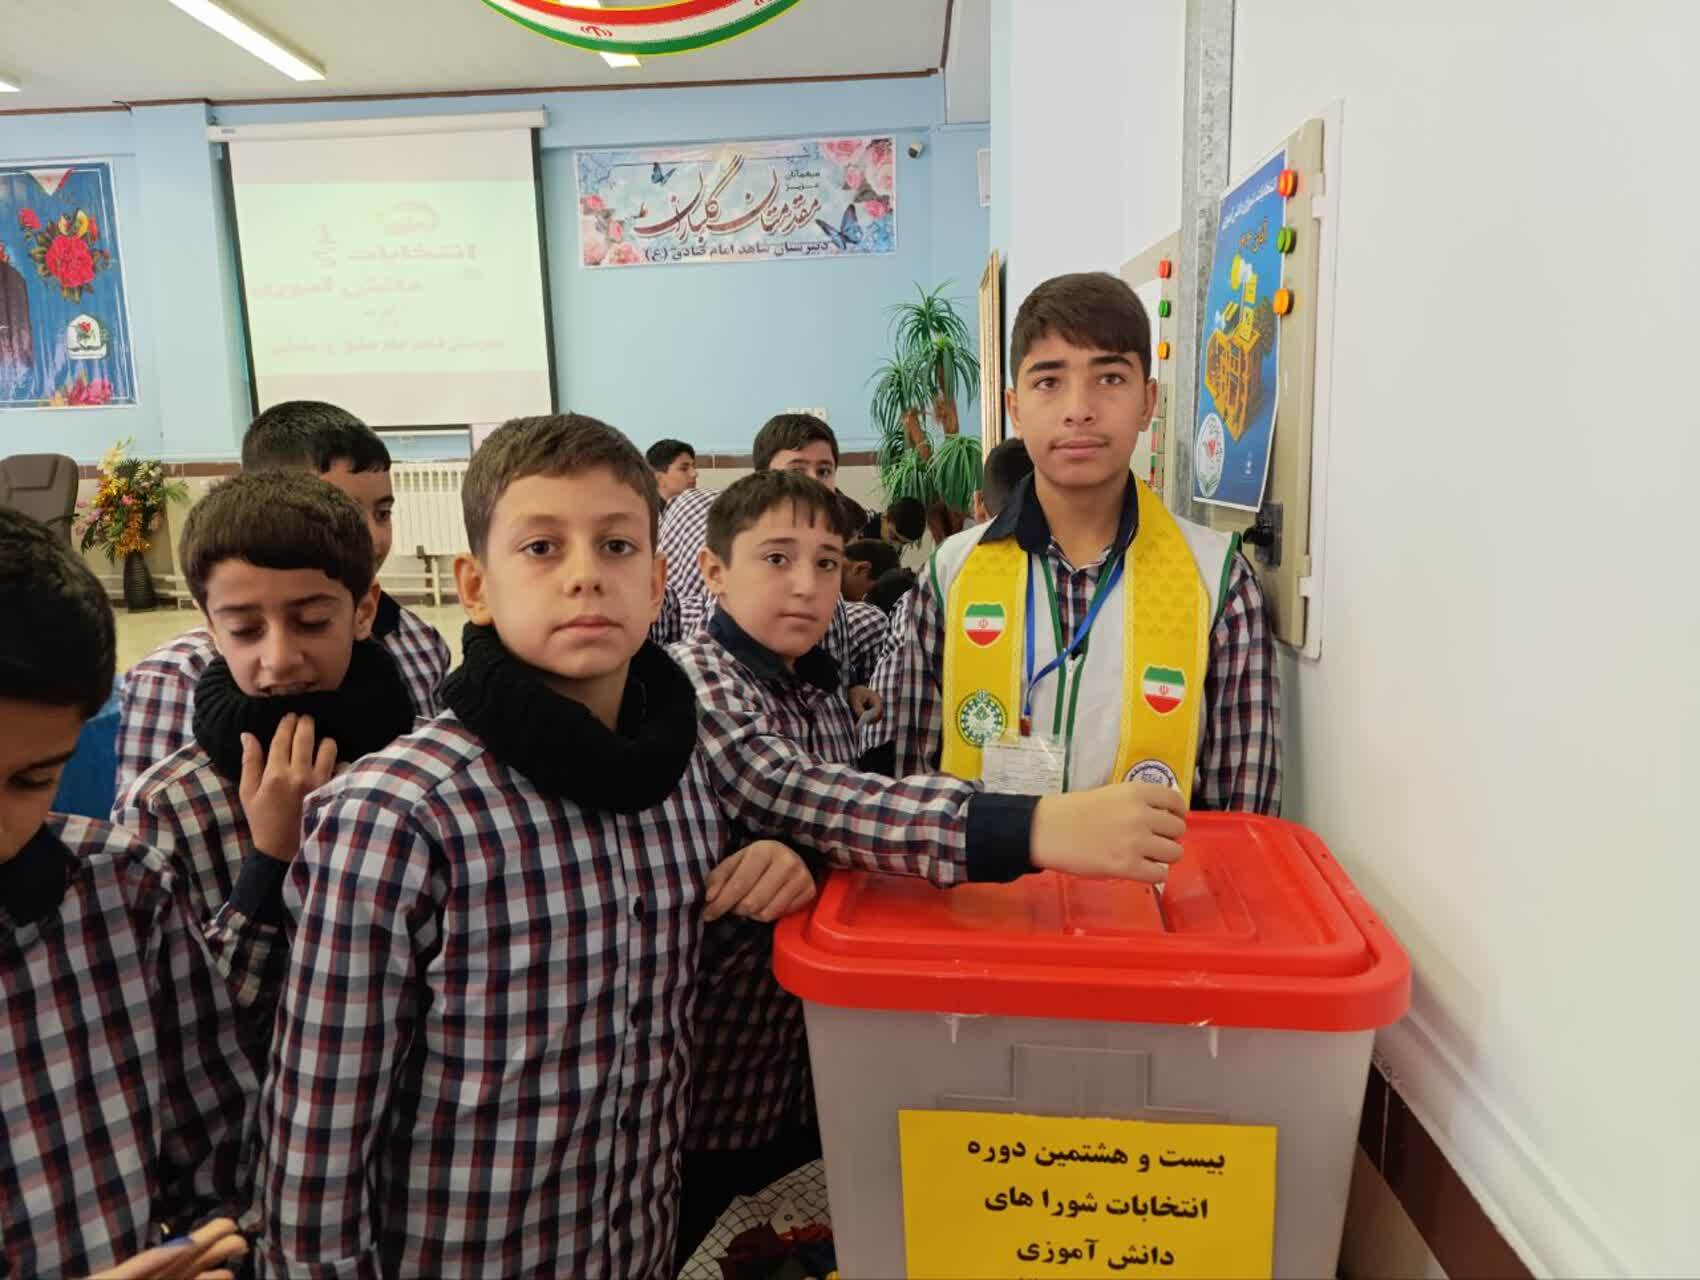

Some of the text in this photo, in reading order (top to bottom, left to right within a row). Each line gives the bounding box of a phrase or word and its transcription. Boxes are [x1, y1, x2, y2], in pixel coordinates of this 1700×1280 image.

[711, 244, 735, 257] امام
[967, 1140, 1226, 1176] بیست و هشتمین دوره
[984, 1185, 1209, 1223] انتخابات شورا های
[1016, 1237, 1175, 1271] دانش آموزی
